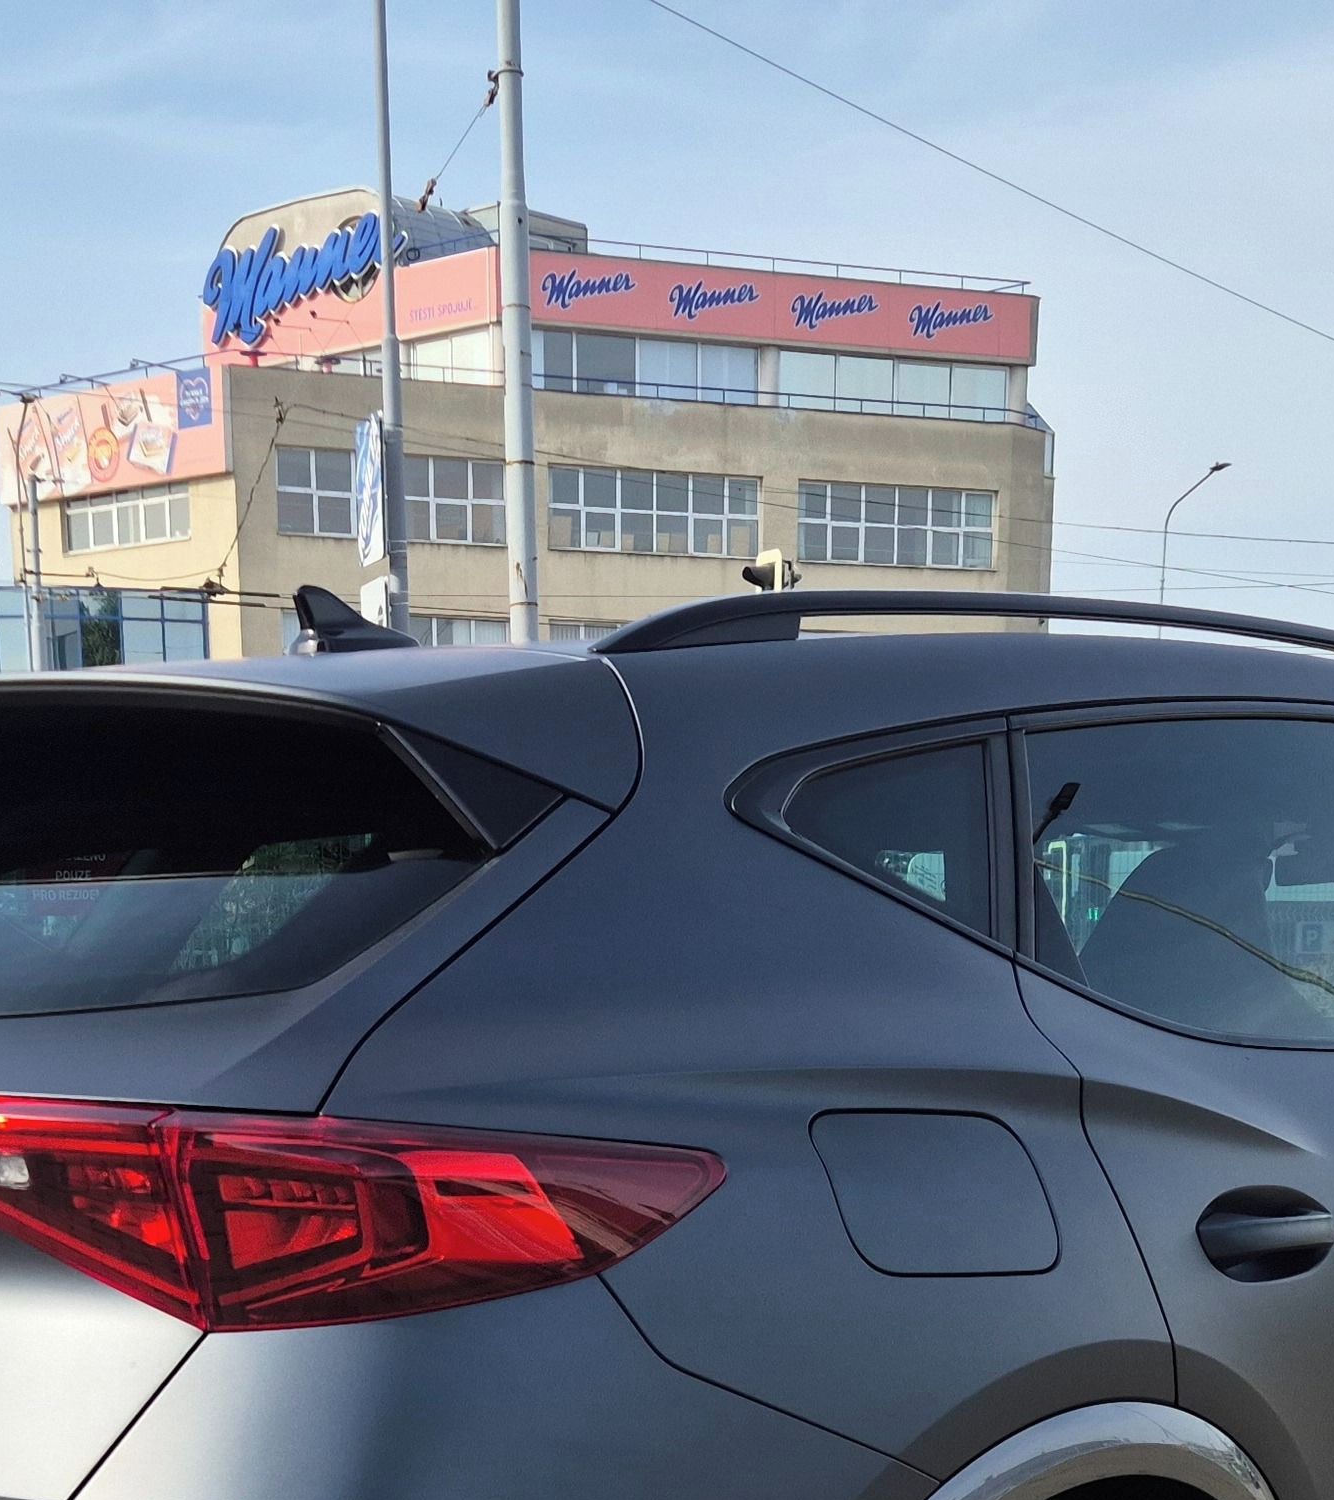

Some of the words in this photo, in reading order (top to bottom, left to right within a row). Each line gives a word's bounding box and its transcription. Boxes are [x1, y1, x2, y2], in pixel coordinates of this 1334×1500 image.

[542, 269, 636, 309] Manner
[669, 281, 759, 320] Manner
[791, 291, 878, 330] Manner
[909, 301, 994, 339] Manner
[32, 888, 56, 900] PRO
[55, 870, 92, 880] POUZE
